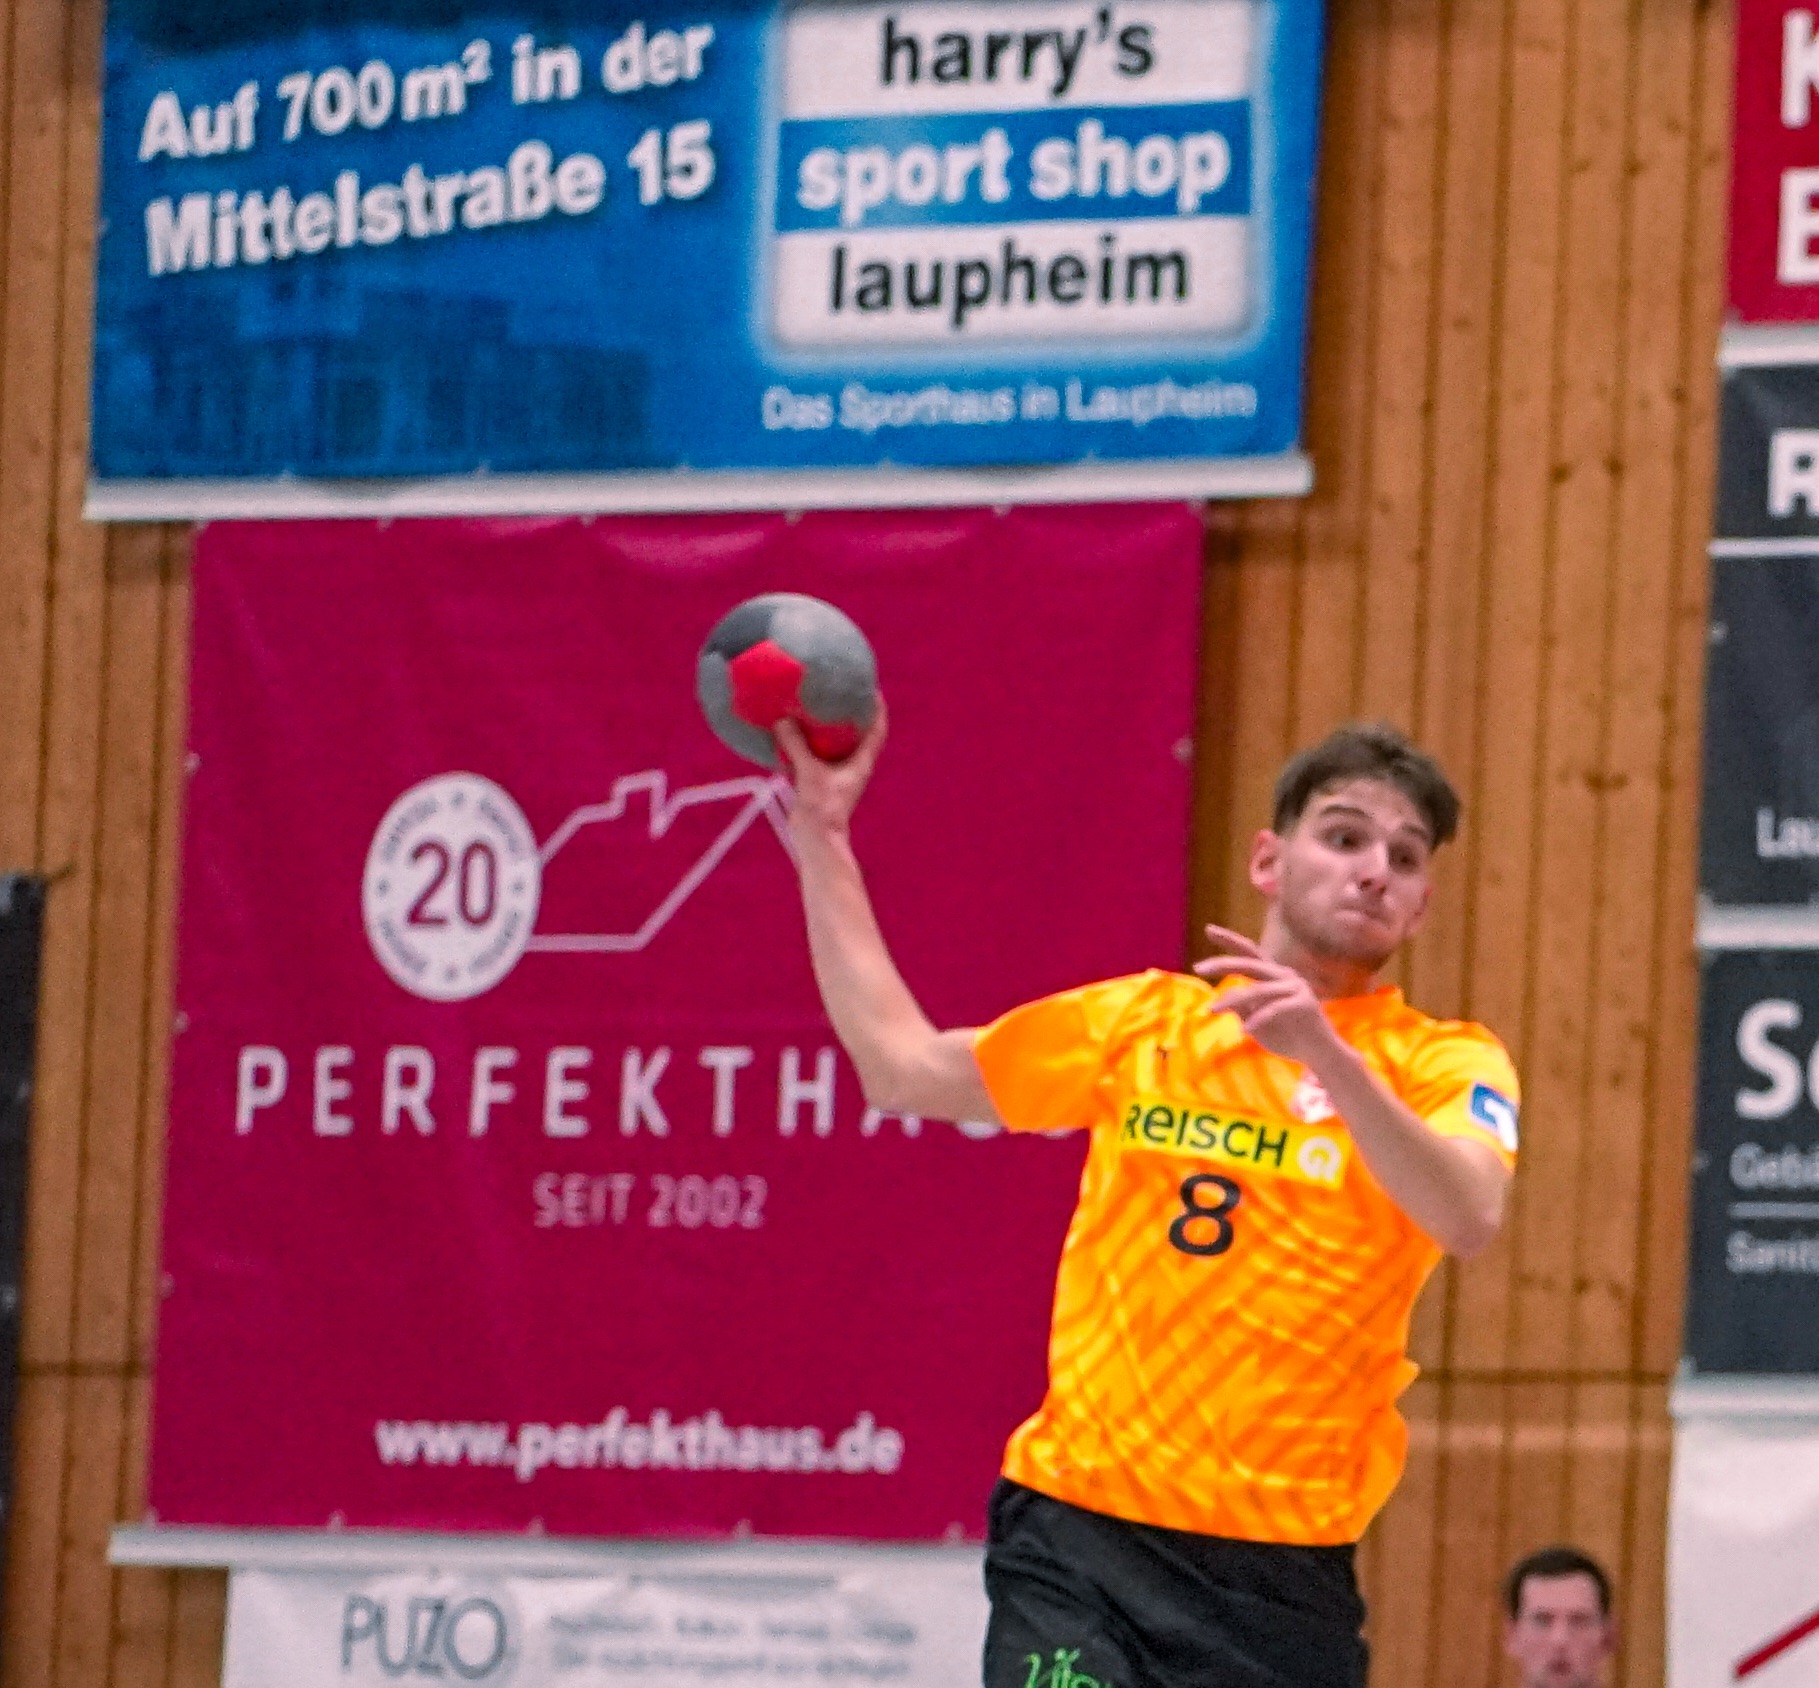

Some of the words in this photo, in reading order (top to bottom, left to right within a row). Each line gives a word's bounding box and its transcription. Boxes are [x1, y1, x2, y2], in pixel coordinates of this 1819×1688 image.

[137, 81, 259, 162] Auf
[512, 33, 581, 104] in
[602, 20, 714, 93] der
[880, 7, 1157, 98] harry's
[144, 139, 605, 278] Mittelstraße
[627, 119, 715, 207] 15
[797, 126, 1012, 230] sport
[1029, 118, 1231, 214] shop
[829, 233, 1189, 329] laupheim
[761, 384, 834, 431] Das
[1020, 383, 1060, 420] in
[1065, 376, 1258, 427] Laupheim
[407, 838, 497, 928] 20
[235, 1045, 1000, 1141] PERFEKTH
[532, 1172, 636, 1228] SEIT
[647, 1172, 769, 1228] 2002
[1168, 1172, 1241, 1257] 8
[374, 1406, 904, 1480] www.perfekthaus.de
